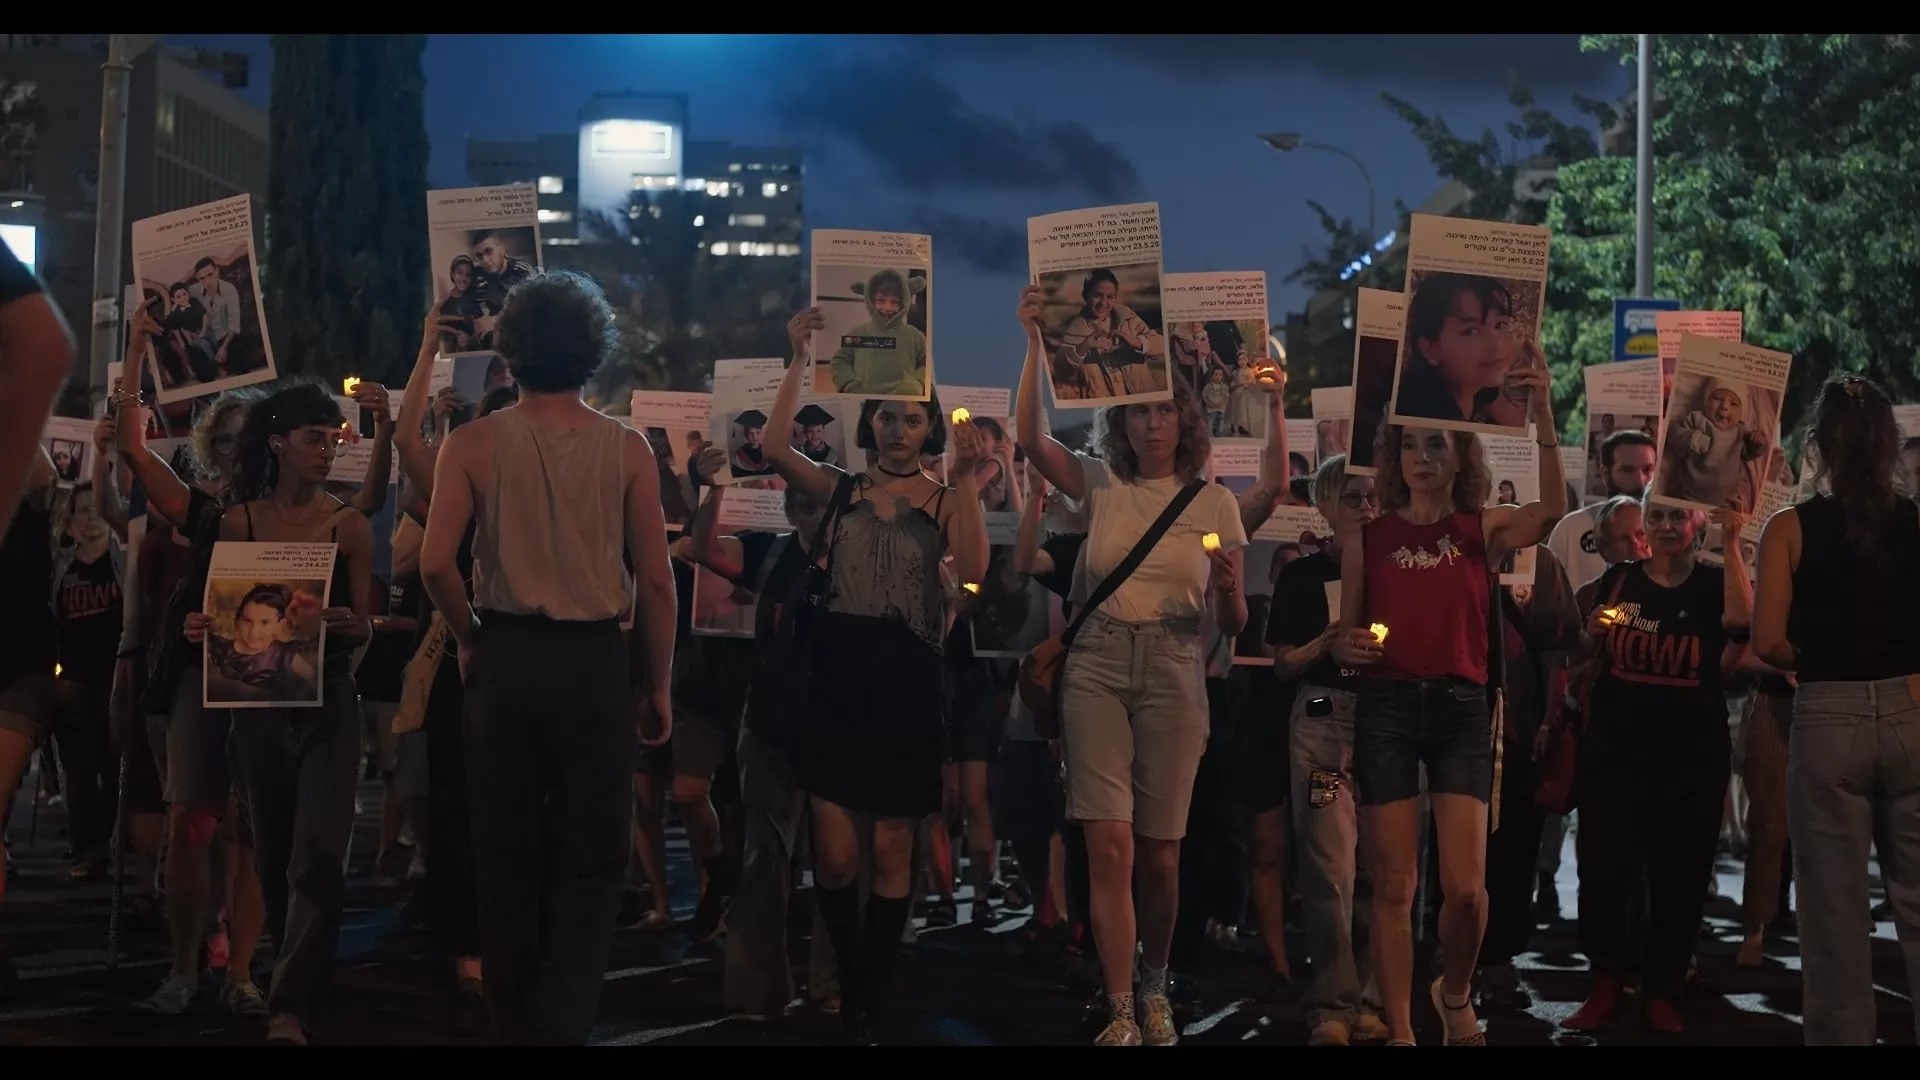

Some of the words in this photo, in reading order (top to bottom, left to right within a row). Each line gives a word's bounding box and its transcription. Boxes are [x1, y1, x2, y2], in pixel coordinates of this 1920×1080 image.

[1059, 232, 1069, 240] קול
[1632, 615, 1661, 633] HOME
[1609, 626, 1700, 679] NOW!
